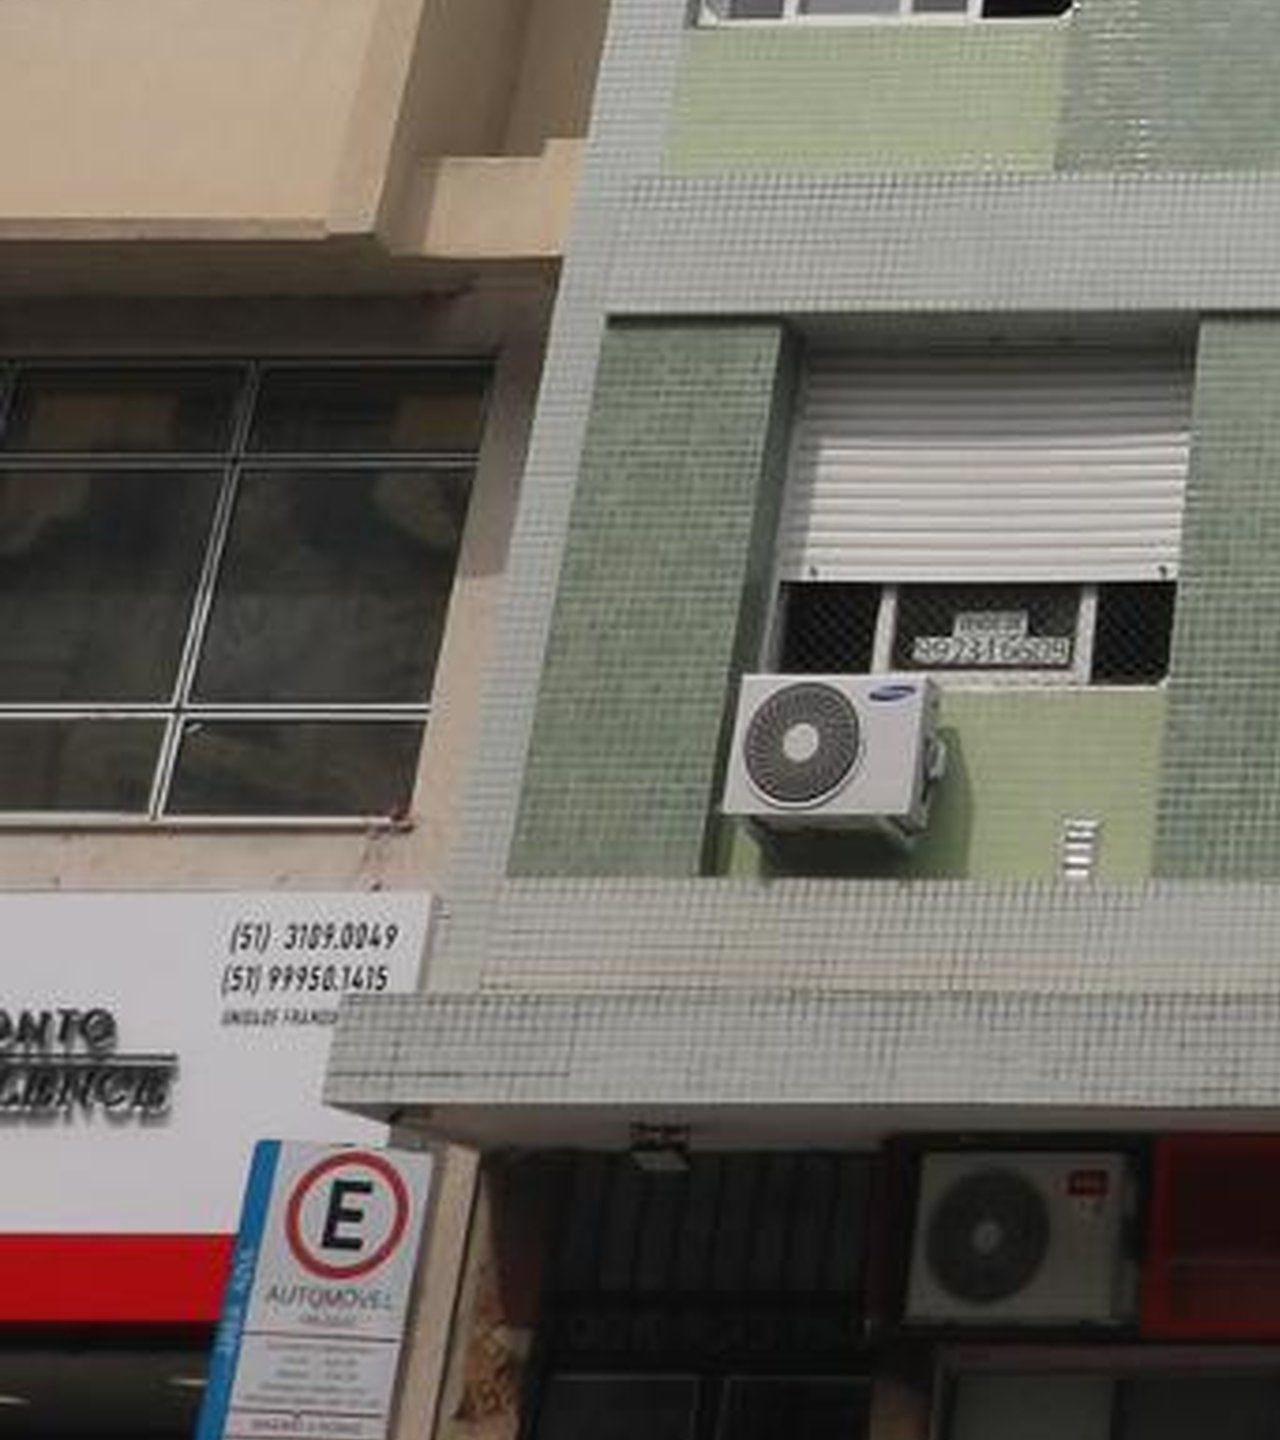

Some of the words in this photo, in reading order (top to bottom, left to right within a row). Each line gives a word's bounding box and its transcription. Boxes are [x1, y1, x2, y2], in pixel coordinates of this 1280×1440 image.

[230, 922, 272, 955] (51)
[222, 964, 263, 996] (51)
[321, 1178, 373, 1252] E
